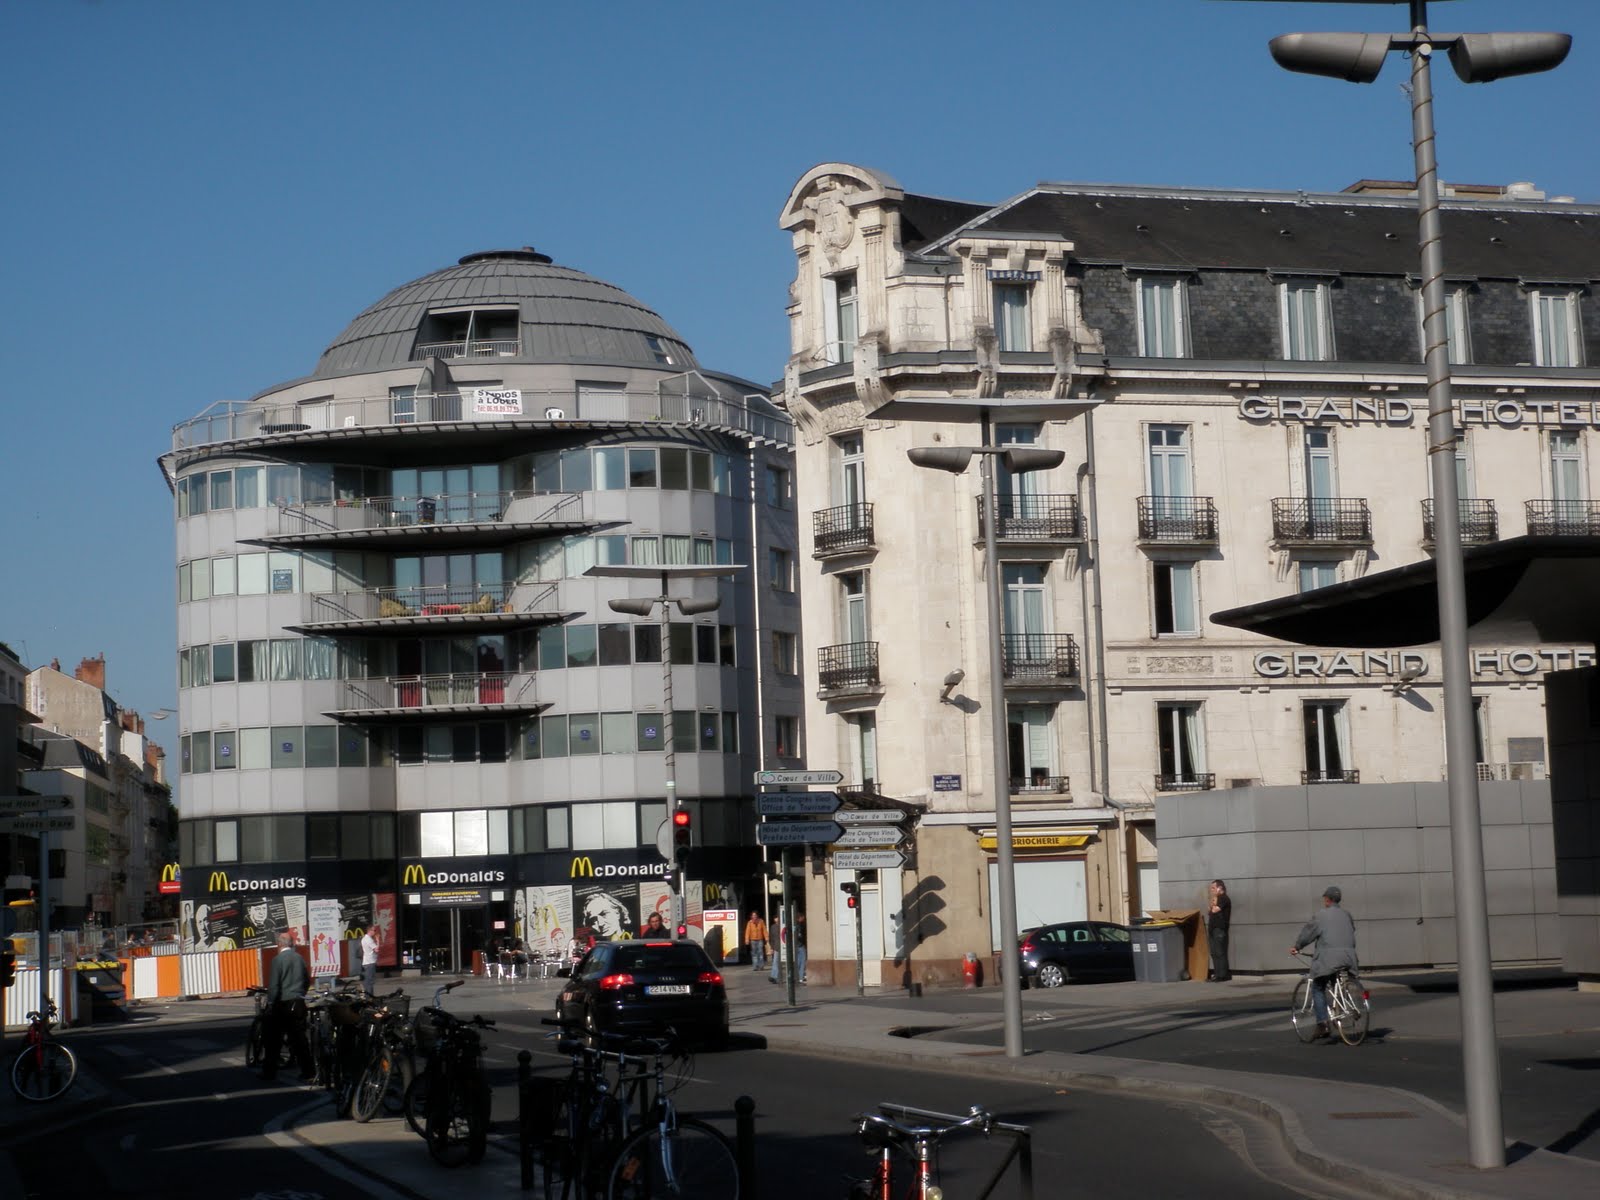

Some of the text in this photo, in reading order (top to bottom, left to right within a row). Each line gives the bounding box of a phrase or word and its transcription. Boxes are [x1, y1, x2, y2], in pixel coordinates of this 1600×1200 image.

[1239, 395, 1414, 424] GRAND
[1254, 651, 1427, 677] GRAND
[803, 774, 812, 782] de
[818, 773, 836, 781] Ville
[790, 824, 832, 833] Département
[1012, 837, 1059, 845] BRIOCHERIE
[209, 871, 307, 892] McDonald's
[403, 864, 505, 886] McDonald's
